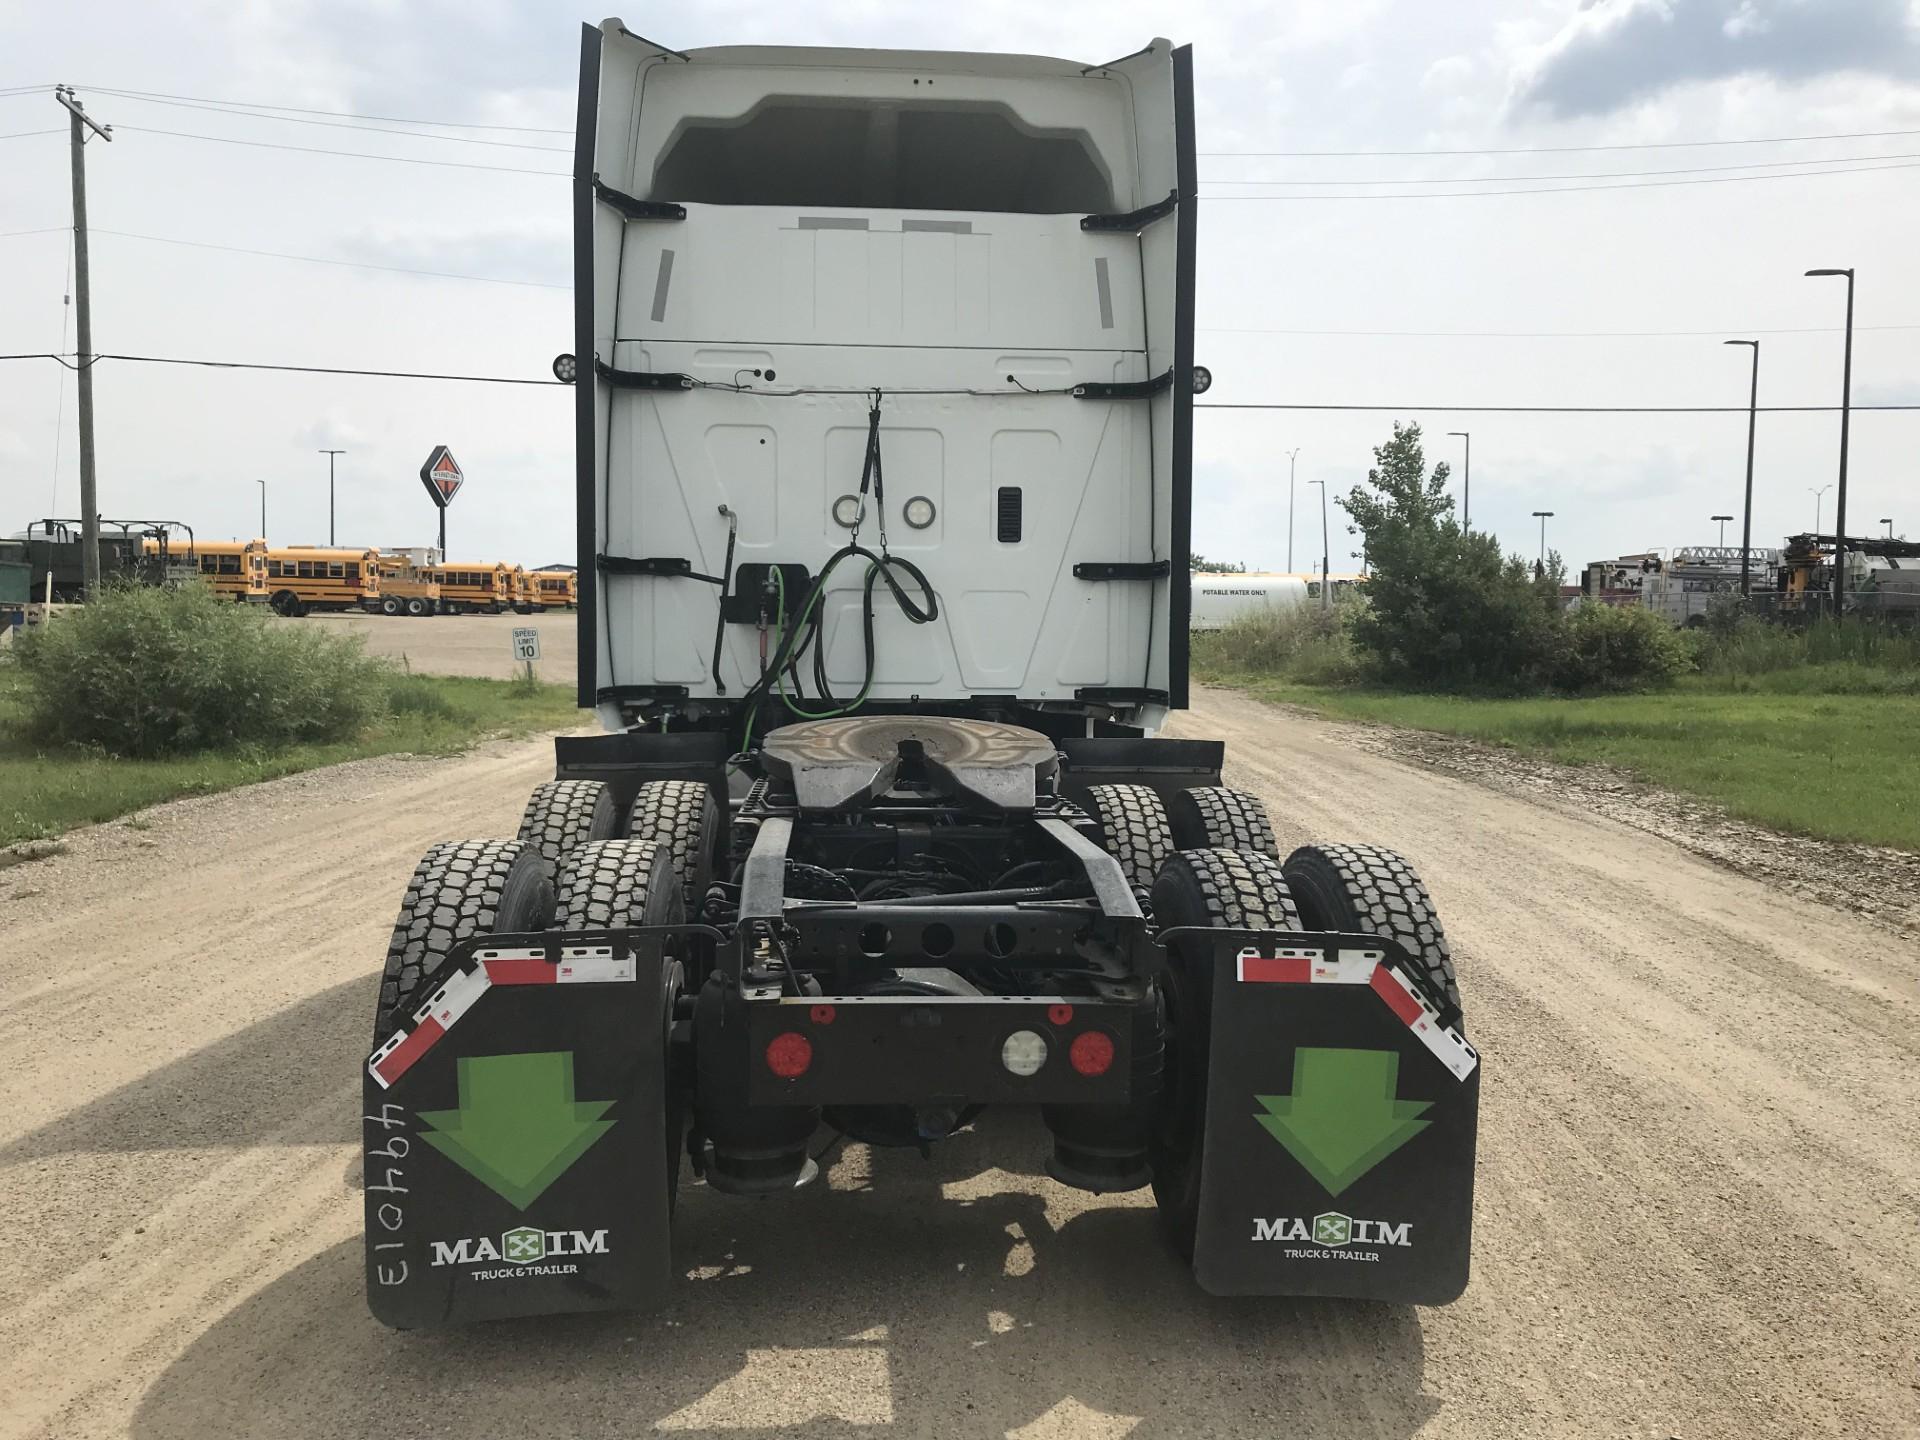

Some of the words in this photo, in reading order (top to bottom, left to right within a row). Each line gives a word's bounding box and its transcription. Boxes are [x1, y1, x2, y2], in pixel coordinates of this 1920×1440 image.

[514, 630, 537, 638] SPEED
[518, 637, 535, 645] LIMIT
[519, 645, 535, 658] 10
[363, 1103, 410, 1286] 494013
[1251, 1211, 1414, 1248] MAXIM
[430, 1226, 610, 1267] MAXIM
[1284, 1249, 1321, 1259] TRUCK
[1331, 1251, 1380, 1262] TRAILER
[471, 1268, 515, 1281] TRUCK
[526, 1264, 578, 1276] TRAILER
